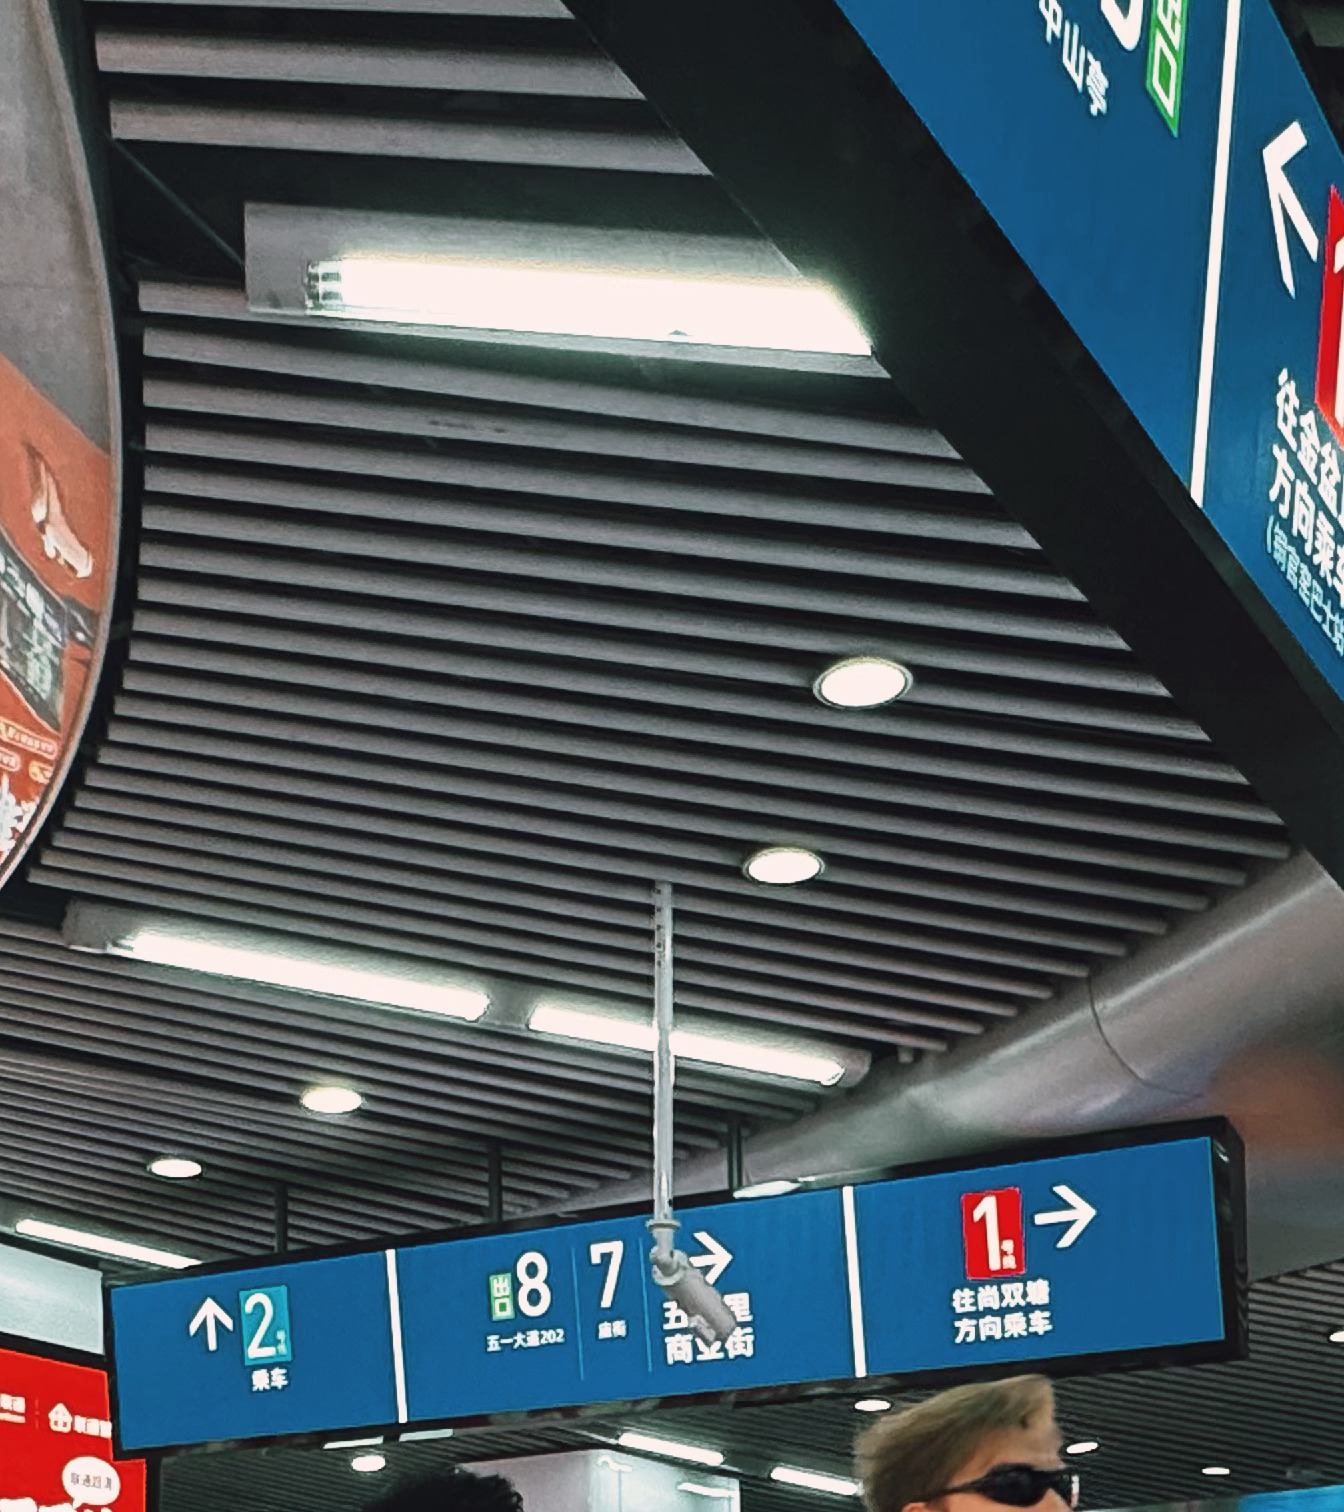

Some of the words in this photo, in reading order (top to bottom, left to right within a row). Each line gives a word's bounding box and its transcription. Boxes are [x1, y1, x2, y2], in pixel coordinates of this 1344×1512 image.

[515, 1251, 552, 1318] 8
[589, 1240, 624, 1308] 7
[952, 1280, 1050, 1314] 往尚双塘
[953, 1311, 1054, 1344] 方向乘车
[251, 1366, 289, 1393] 乘车
